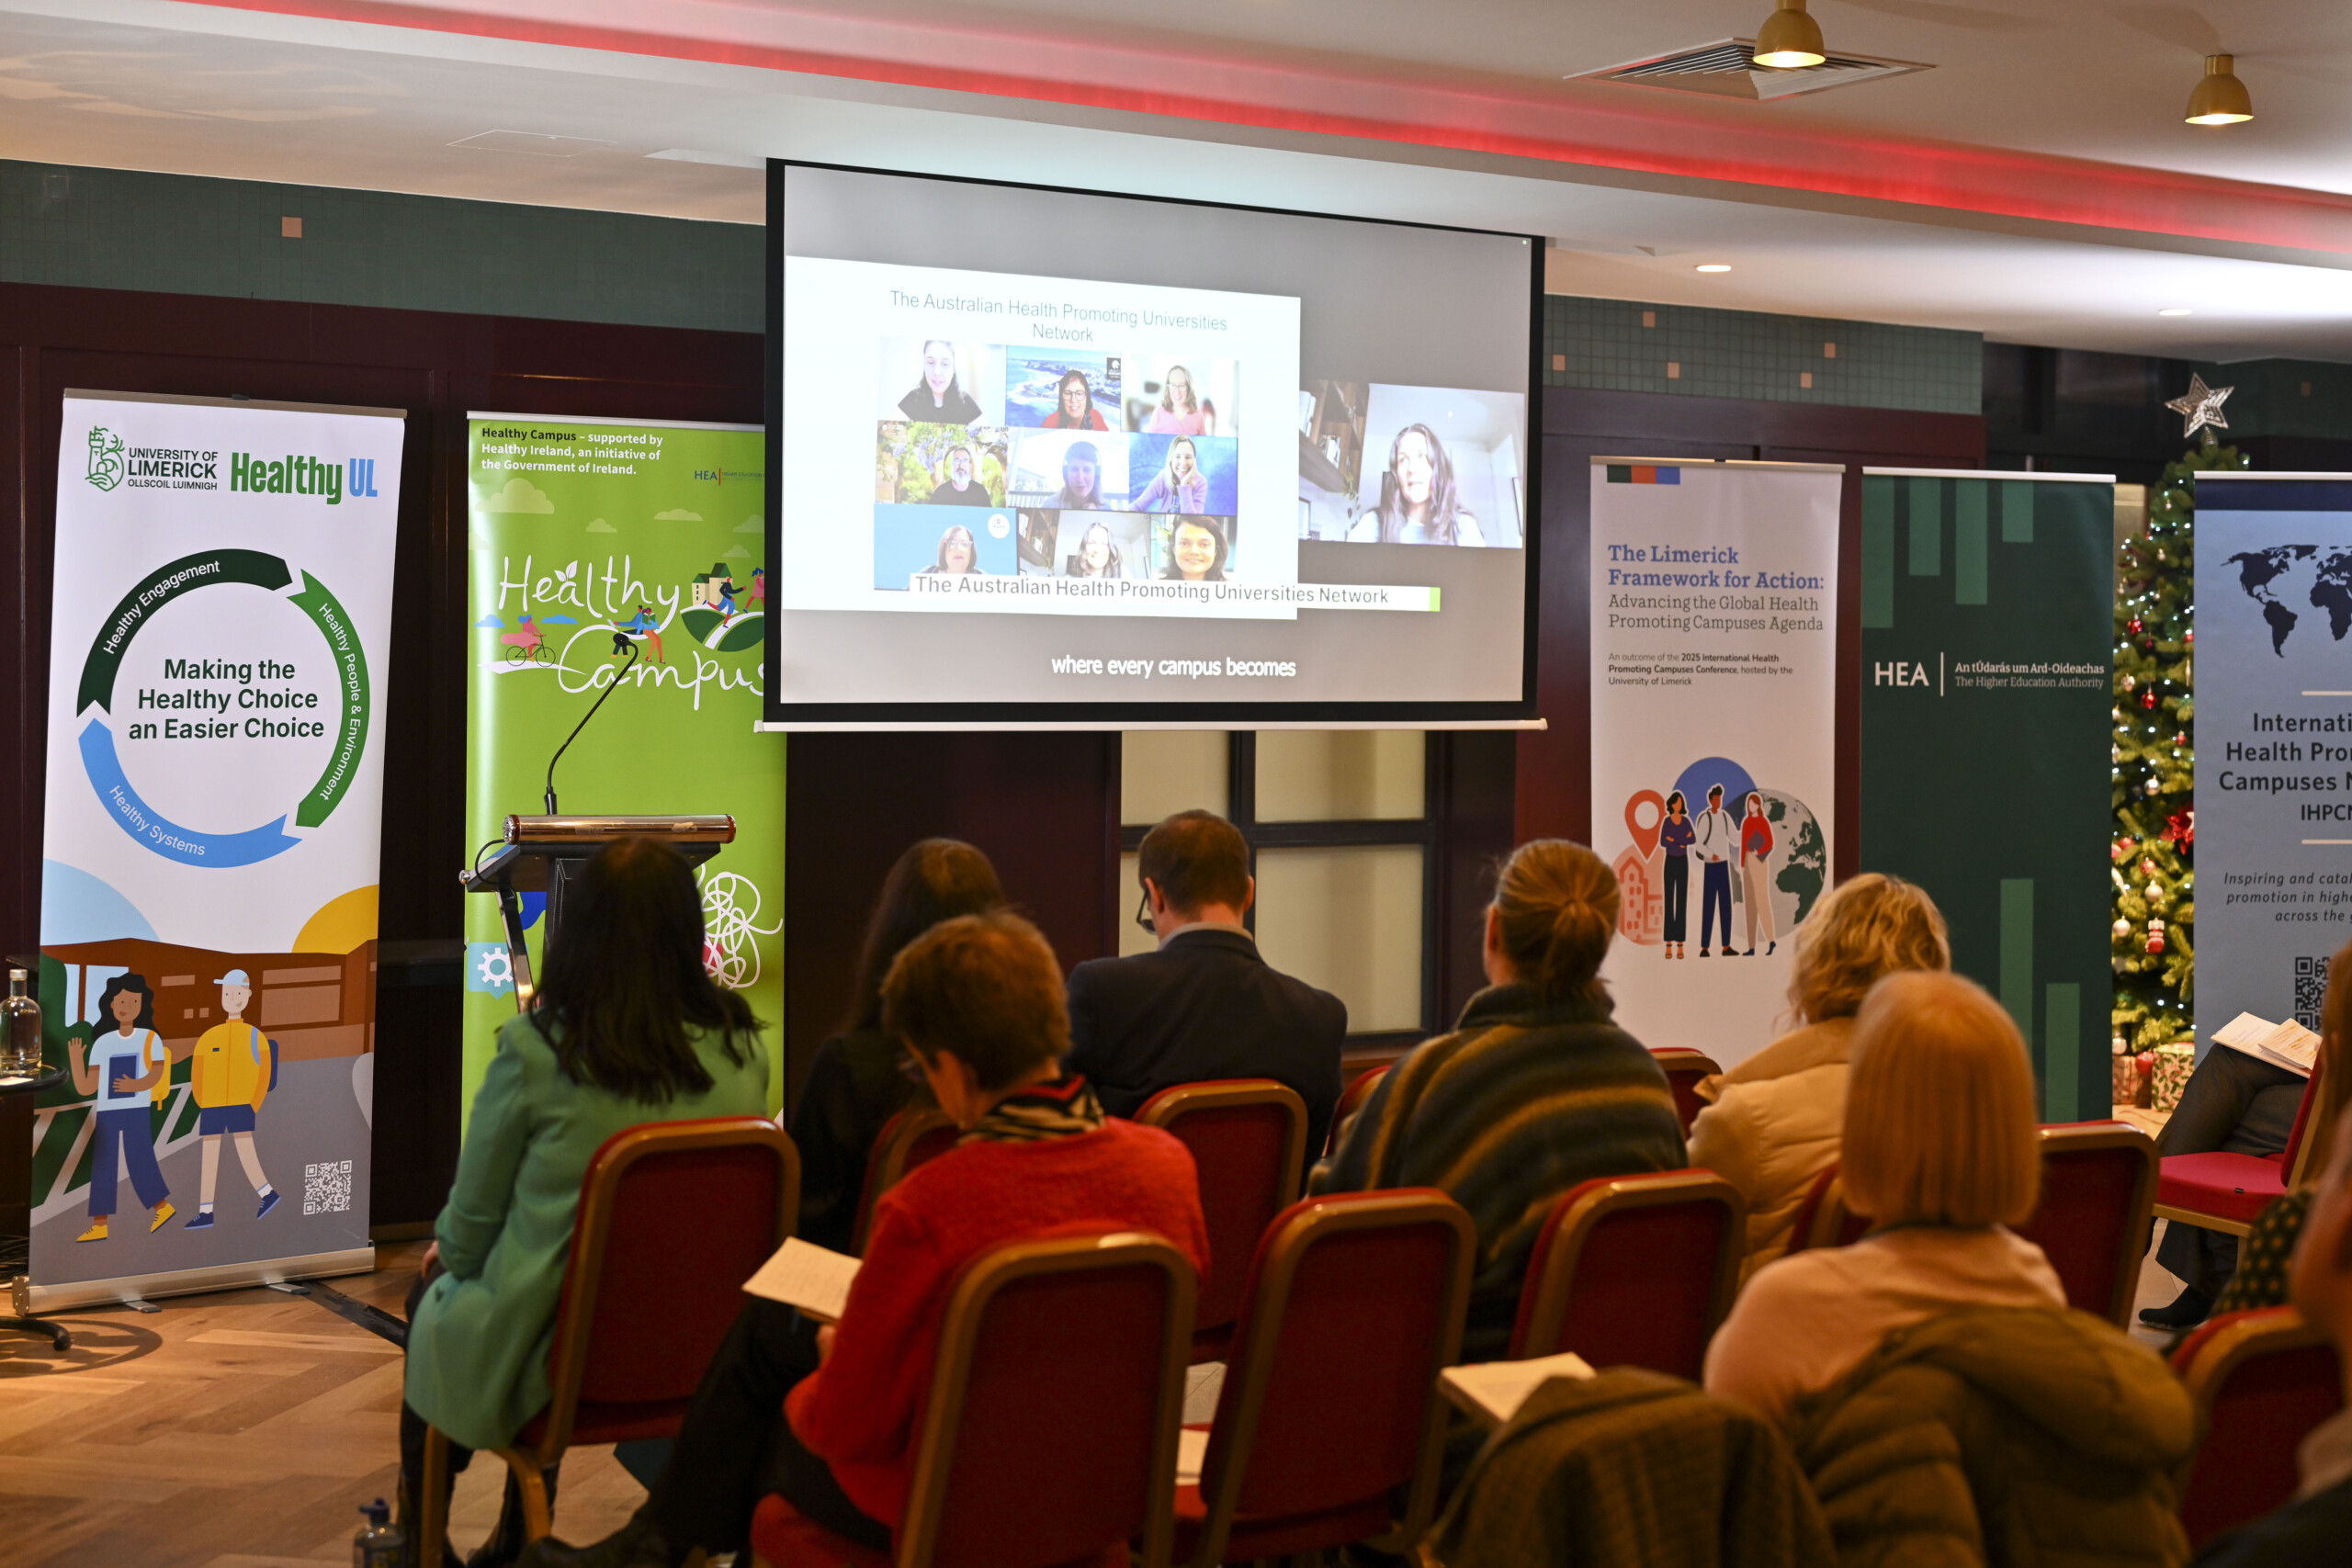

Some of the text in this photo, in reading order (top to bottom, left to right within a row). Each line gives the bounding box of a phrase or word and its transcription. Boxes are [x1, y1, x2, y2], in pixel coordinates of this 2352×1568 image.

[890, 290, 1227, 332] The Australian Health Promoting Universities
[1033, 322, 1093, 343] Network
[482, 427, 528, 441] Healthy
[530, 430, 577, 443] Campus
[588, 434, 647, 445] supported
[649, 434, 663, 447] by
[129, 447, 219, 462] UNIVERSITY OF
[481, 444, 662, 460] Healthy Ireland, an initiative of
[128, 460, 218, 479] LIMERICK
[481, 458, 637, 475] the Government of Ireland.
[694, 469, 718, 480] HEA
[128, 479, 218, 491] OLLSCOIL LUIMNIGH
[230, 452, 379, 505] Healthy UL
[1608, 544, 1739, 564] The Limerick
[1608, 569, 1825, 590] Framework for Action:
[498, 554, 680, 640] Healthy
[915, 576, 1389, 604] The Australian Health Promoting Universities Network
[103, 560, 220, 655] Healthy Engagement
[1608, 593, 1819, 613] Advancing the Global Health
[1609, 614, 1824, 634] Promoting Campuses Agenda
[1051, 654, 1296, 680] where every campus becomes
[1608, 652, 1780, 662] An outcome of the 2025 International Health
[1954, 659, 2105, 675] An tÚdarás um Ard-Oideachas
[164, 658, 296, 685] Making the
[1608, 665, 1793, 676] Promoting Campuses Conference, hosted by the
[1874, 661, 1930, 686] HEA
[1608, 677, 1692, 687] University of Limerick
[1954, 675, 2104, 691] The Higher Education Authority
[138, 687, 318, 715] Healthy Choice
[318, 603, 362, 801] Healthy People & Environment
[129, 716, 324, 739] an Easier Choice
[2226, 741, 2352, 761] Health Pro
[2219, 771, 2337, 795] Campuses
[109, 784, 206, 856] Healthy Systems
[2223, 872, 2285, 887] Inspiring
[2289, 872, 2314, 885] and
[2226, 890, 2298, 906] promotion
[2302, 891, 2314, 903] in
[2275, 911, 2318, 922] across
[2324, 908, 2345, 922] the
